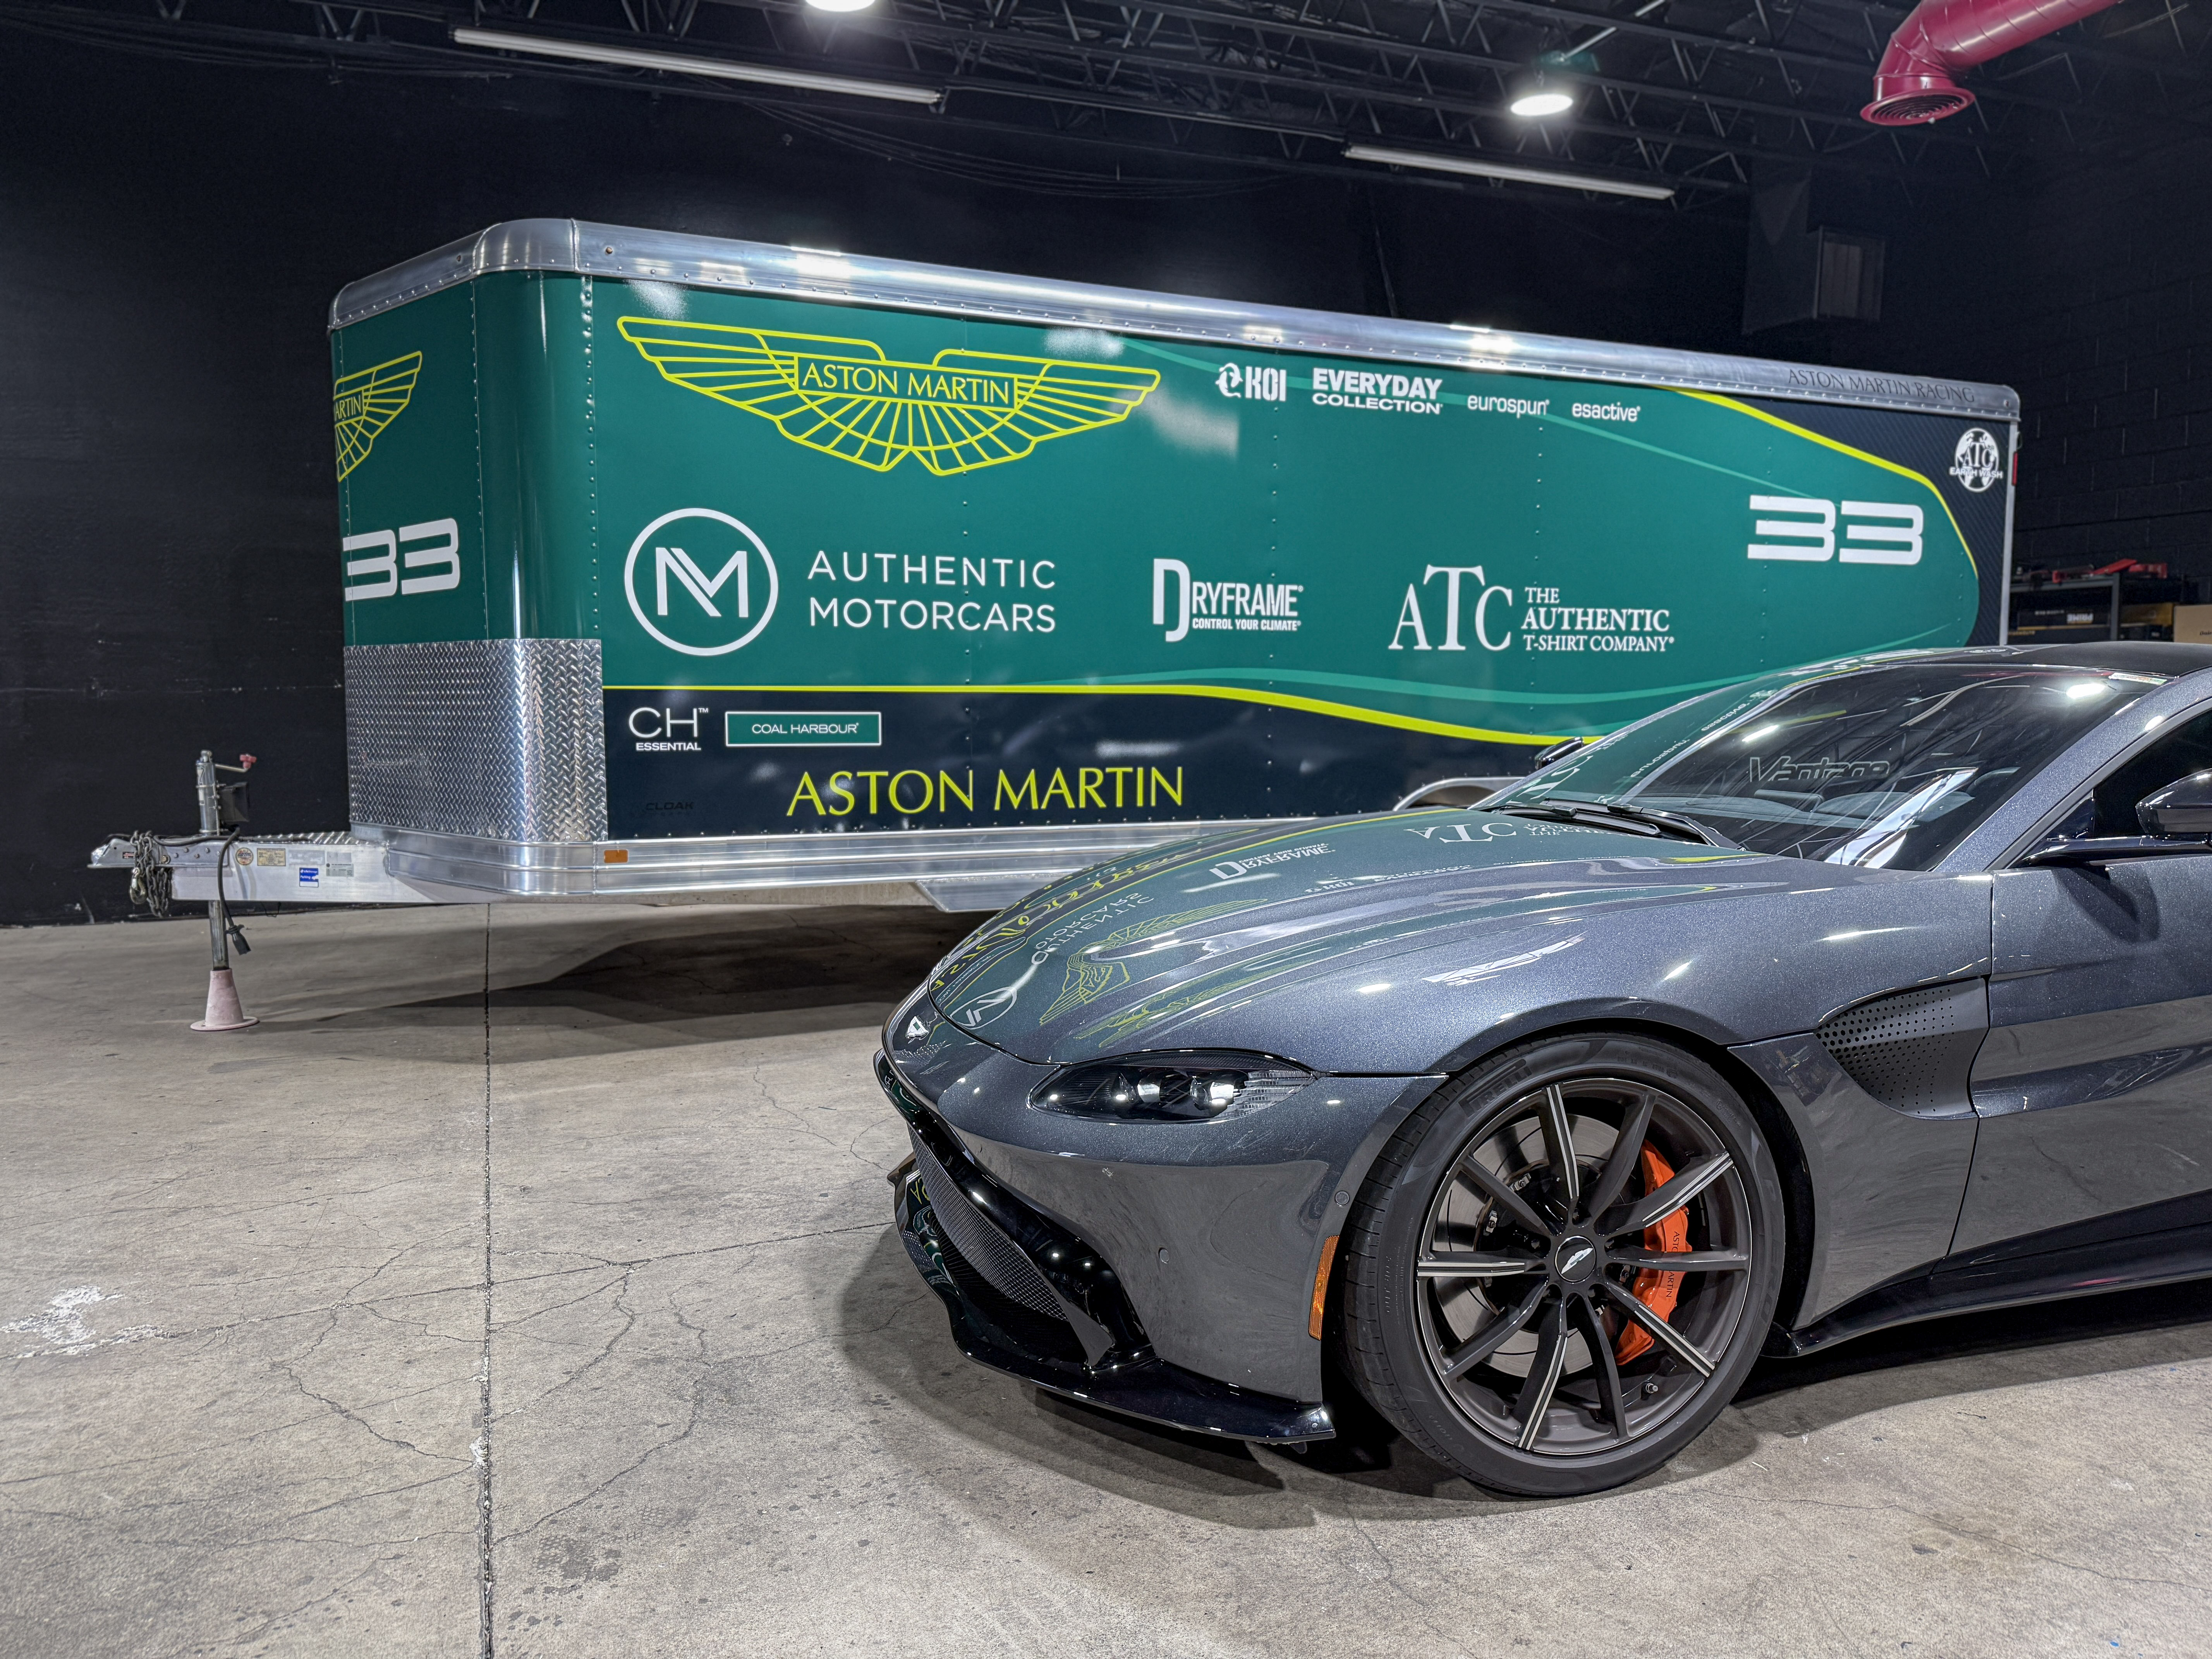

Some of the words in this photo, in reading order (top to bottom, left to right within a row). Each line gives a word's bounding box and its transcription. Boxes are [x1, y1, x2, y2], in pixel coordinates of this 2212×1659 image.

[803, 362, 897, 394] ASTON
[908, 372, 1008, 404] MARTIN
[1245, 366, 1286, 402] KOI
[1312, 368, 1443, 400] EVERYDAY
[1789, 369, 1844, 388] ASTON
[1849, 375, 1911, 395] MARTIN
[1914, 382, 1974, 402] RACING
[334, 395, 361, 422] ARTIN
[1963, 441, 1993, 468] ATC
[1949, 467, 1977, 477] EARTH
[1979, 469, 2003, 479] WASH
[1747, 495, 1923, 565] 33
[343, 518, 460, 601] 33
[807, 550, 1055, 589] AUTHENTIC
[1389, 564, 1513, 652] ATC
[1525, 587, 1559, 603] THE
[809, 598, 1056, 633] MOTORCARS
[1192, 618, 1233, 629] CONTROL
[1235, 619, 1259, 630] YOUR
[1521, 607, 1669, 632] AUTHENTIC
[1523, 634, 1588, 651] T-SHIRT
[752, 723, 788, 734] COAL
[636, 742, 701, 751] ESSENTIAL
[786, 770, 973, 816] ASTON
[994, 767, 1182, 810] MARTIN
[646, 802, 695, 810] CLOAK
[1458, 1059, 1532, 1117] PIRELLI
[1671, 1231, 1680, 1252] ASTO
[1666, 1271, 1674, 1298] ARTIN
